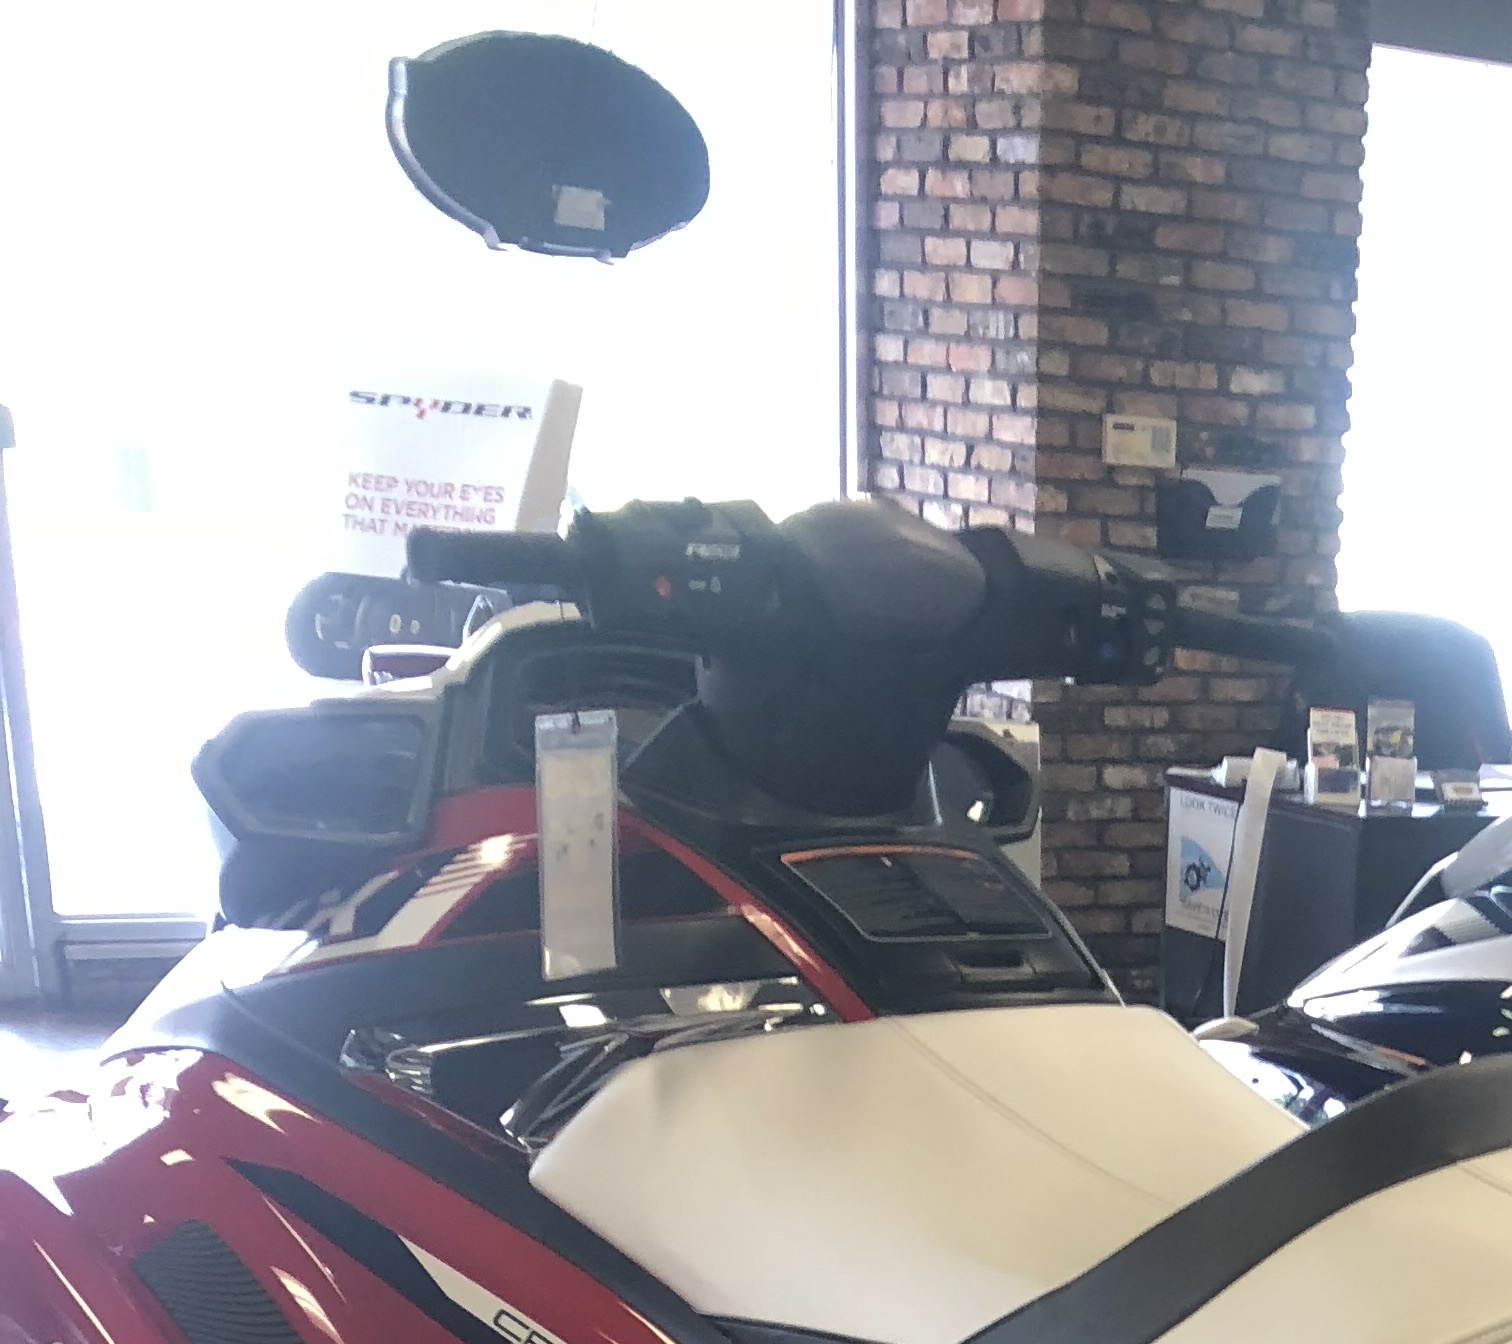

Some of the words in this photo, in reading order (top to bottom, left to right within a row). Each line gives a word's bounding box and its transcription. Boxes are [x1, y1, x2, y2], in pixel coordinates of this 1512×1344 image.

[349, 390, 533, 420] SPYDER
[348, 472, 398, 492] KEEP
[405, 479, 455, 500] YOUR
[345, 492, 374, 513] ON
[381, 498, 496, 524] EVERYTHING
[343, 514, 388, 534] THAT
